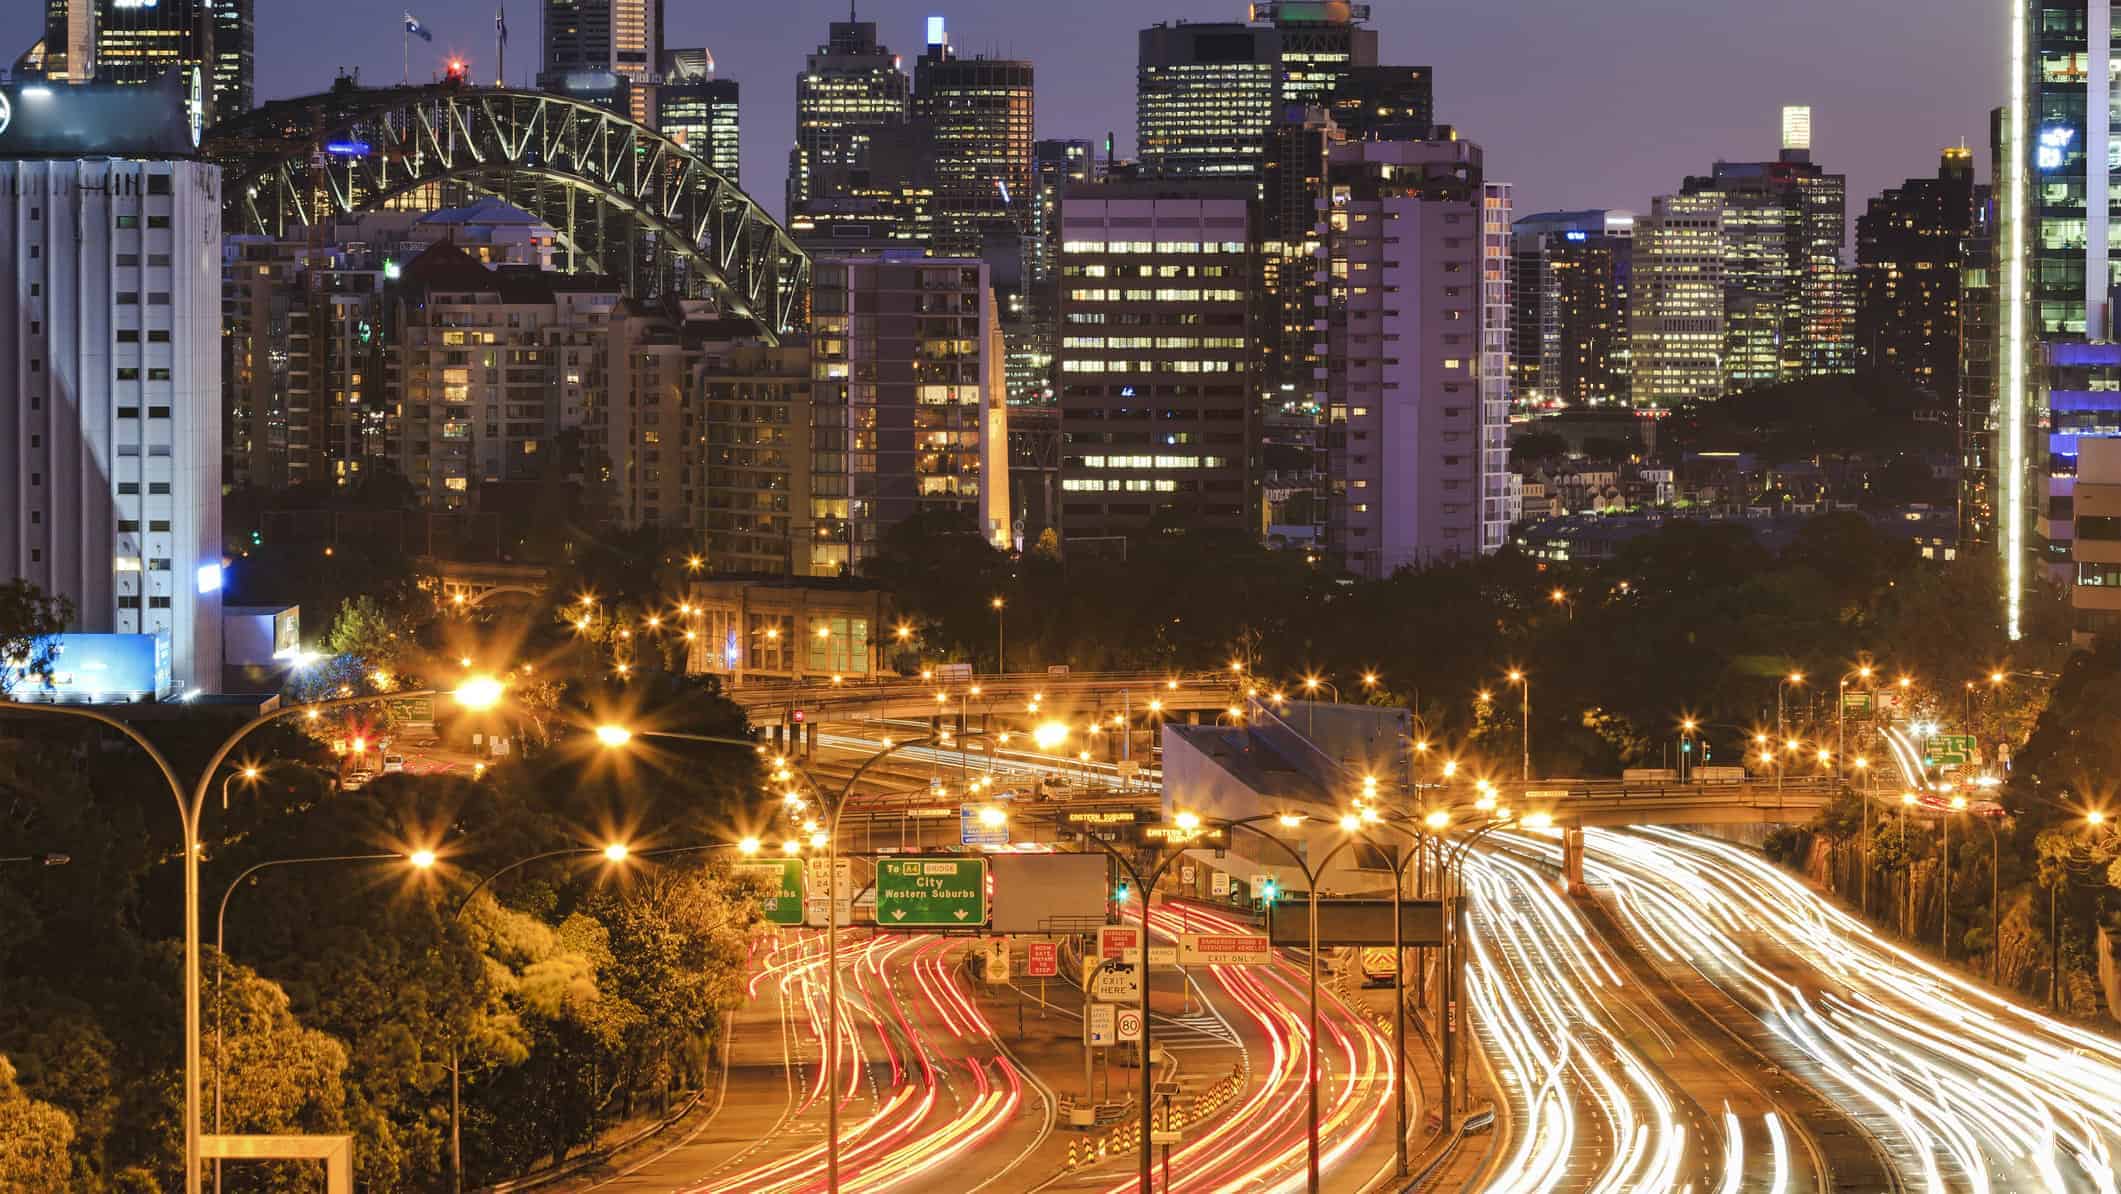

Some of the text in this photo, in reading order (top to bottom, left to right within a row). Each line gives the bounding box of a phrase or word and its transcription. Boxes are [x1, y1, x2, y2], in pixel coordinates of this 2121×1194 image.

[887, 864, 900, 873] To
[905, 864, 919, 873] A4
[916, 877, 943, 889] City
[885, 889, 975, 898] Western Suburbs
[1103, 977, 1125, 985] EXIT
[1101, 986, 1127, 994] HERE
[1122, 1020, 1138, 1030] 80
